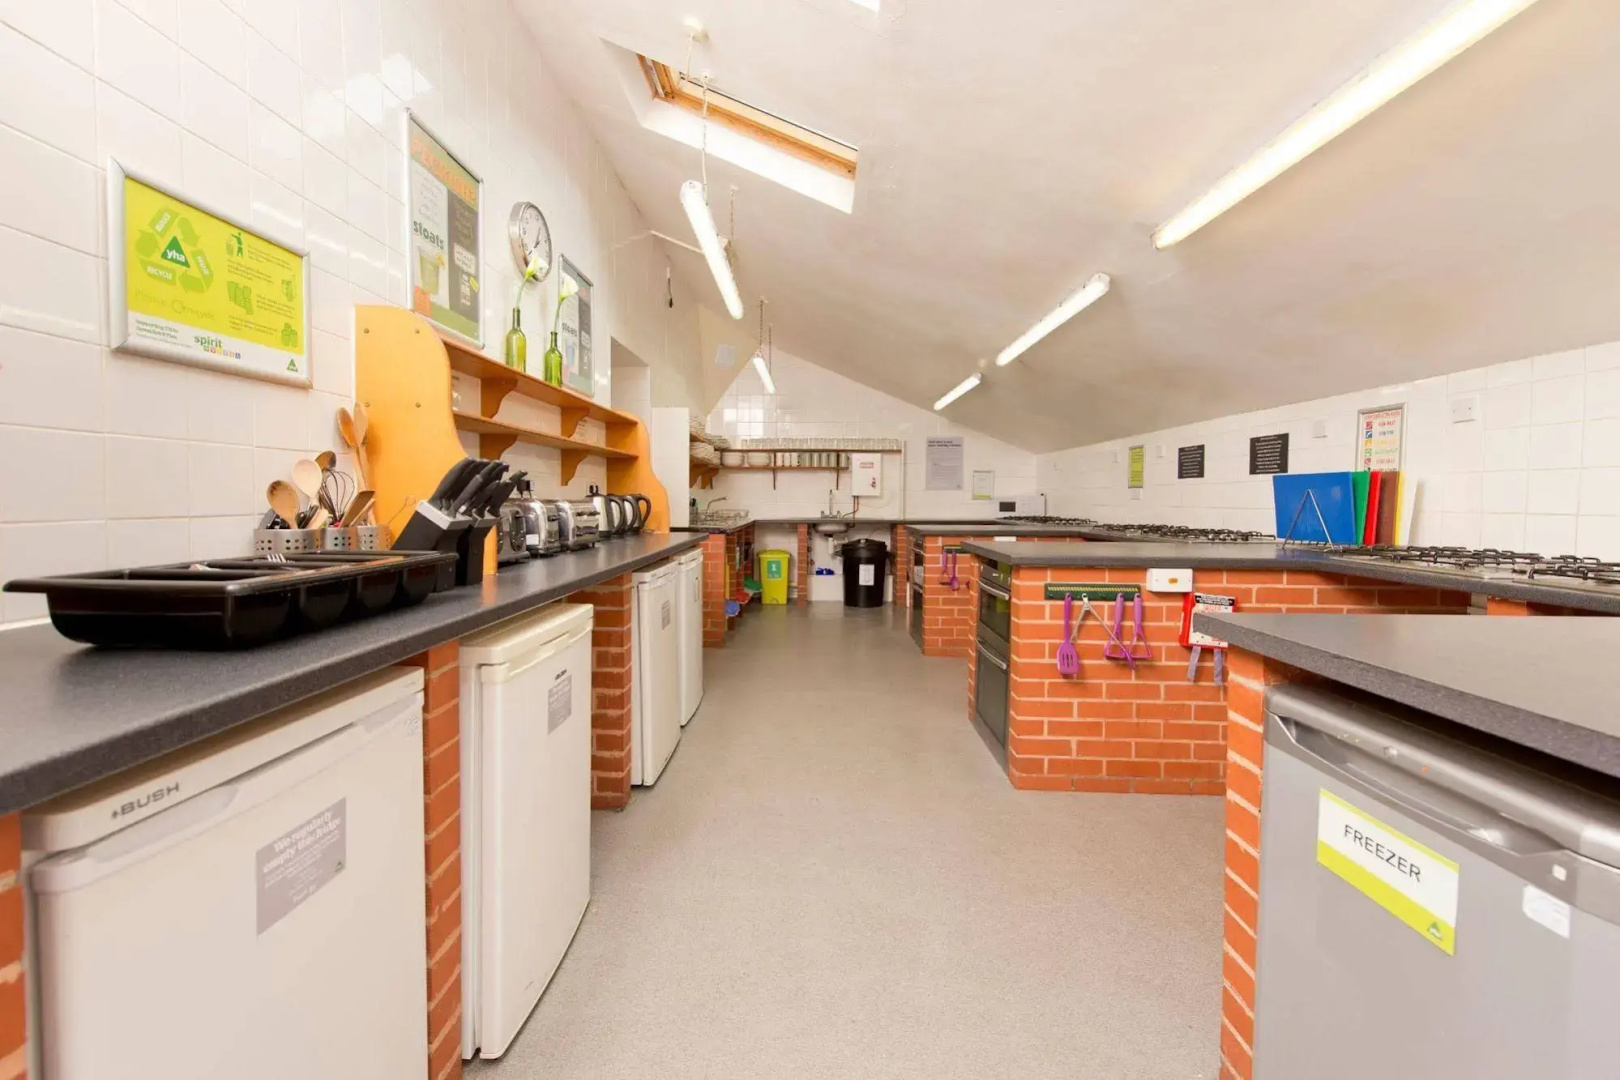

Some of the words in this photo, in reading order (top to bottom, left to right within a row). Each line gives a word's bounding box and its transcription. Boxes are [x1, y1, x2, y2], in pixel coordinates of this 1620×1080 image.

[413, 220, 444, 250] stoats
[166, 249, 185, 263] yha
[194, 336, 222, 349] spirit
[121, 782, 179, 815] BUSH
[1344, 824, 1421, 882] FREEZER
